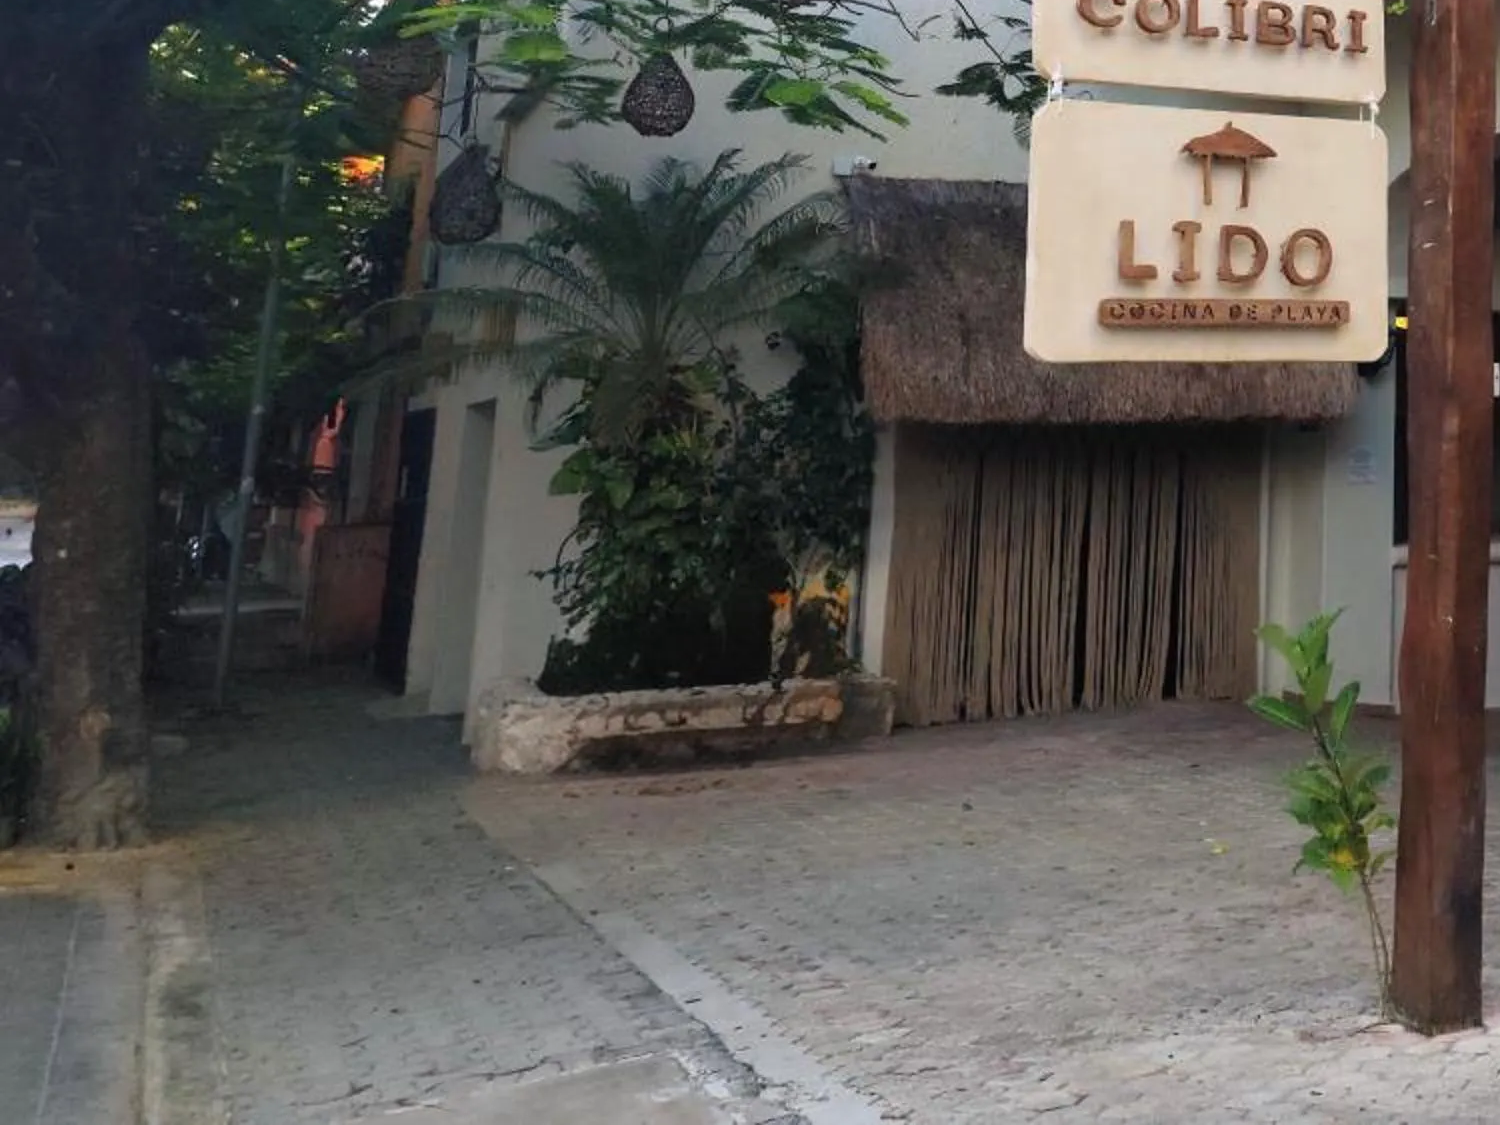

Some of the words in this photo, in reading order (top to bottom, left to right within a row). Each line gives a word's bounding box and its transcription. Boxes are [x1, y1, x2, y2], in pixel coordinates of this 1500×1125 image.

[1117, 220, 1333, 287] LIDO
[1109, 302, 1216, 321] COCINA
[1229, 303, 1258, 321] DE
[1271, 304, 1343, 321] PLAYA
